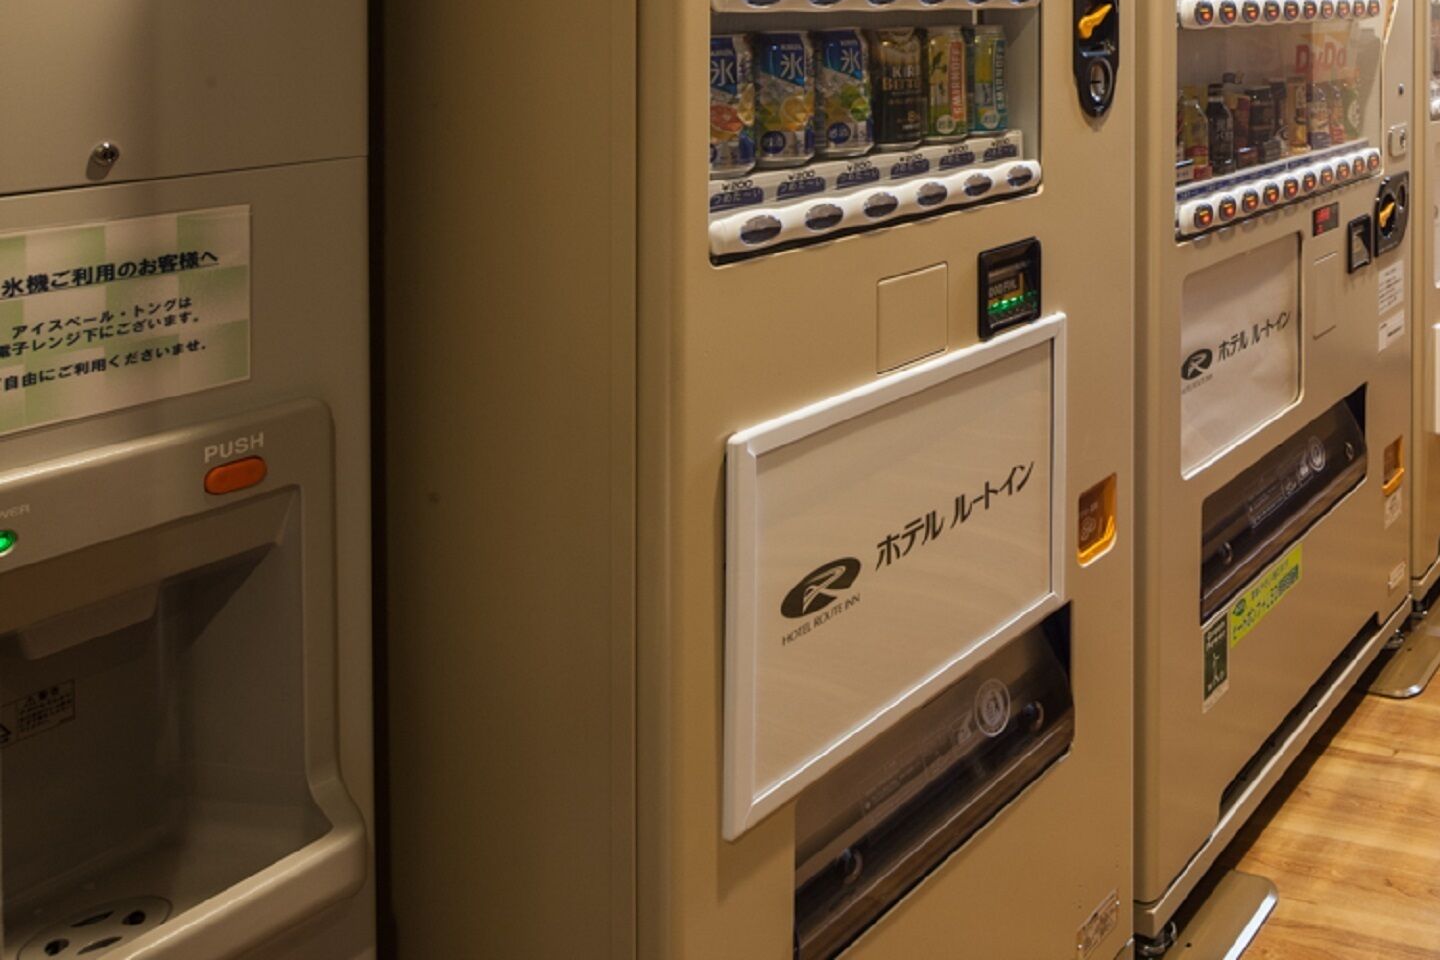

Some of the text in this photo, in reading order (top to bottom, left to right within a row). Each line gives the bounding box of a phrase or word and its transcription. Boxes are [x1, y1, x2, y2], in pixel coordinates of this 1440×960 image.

[711, 57, 735, 87] 氷
[779, 52, 803, 80] 氷
[840, 47, 861, 74] 氷
[1218, 330, 1248, 362] ホテル
[203, 432, 265, 464] PUSH
[875, 460, 1034, 571] ホテル ルートイン
[782, 593, 861, 647] HOTEL ROUTE INN
